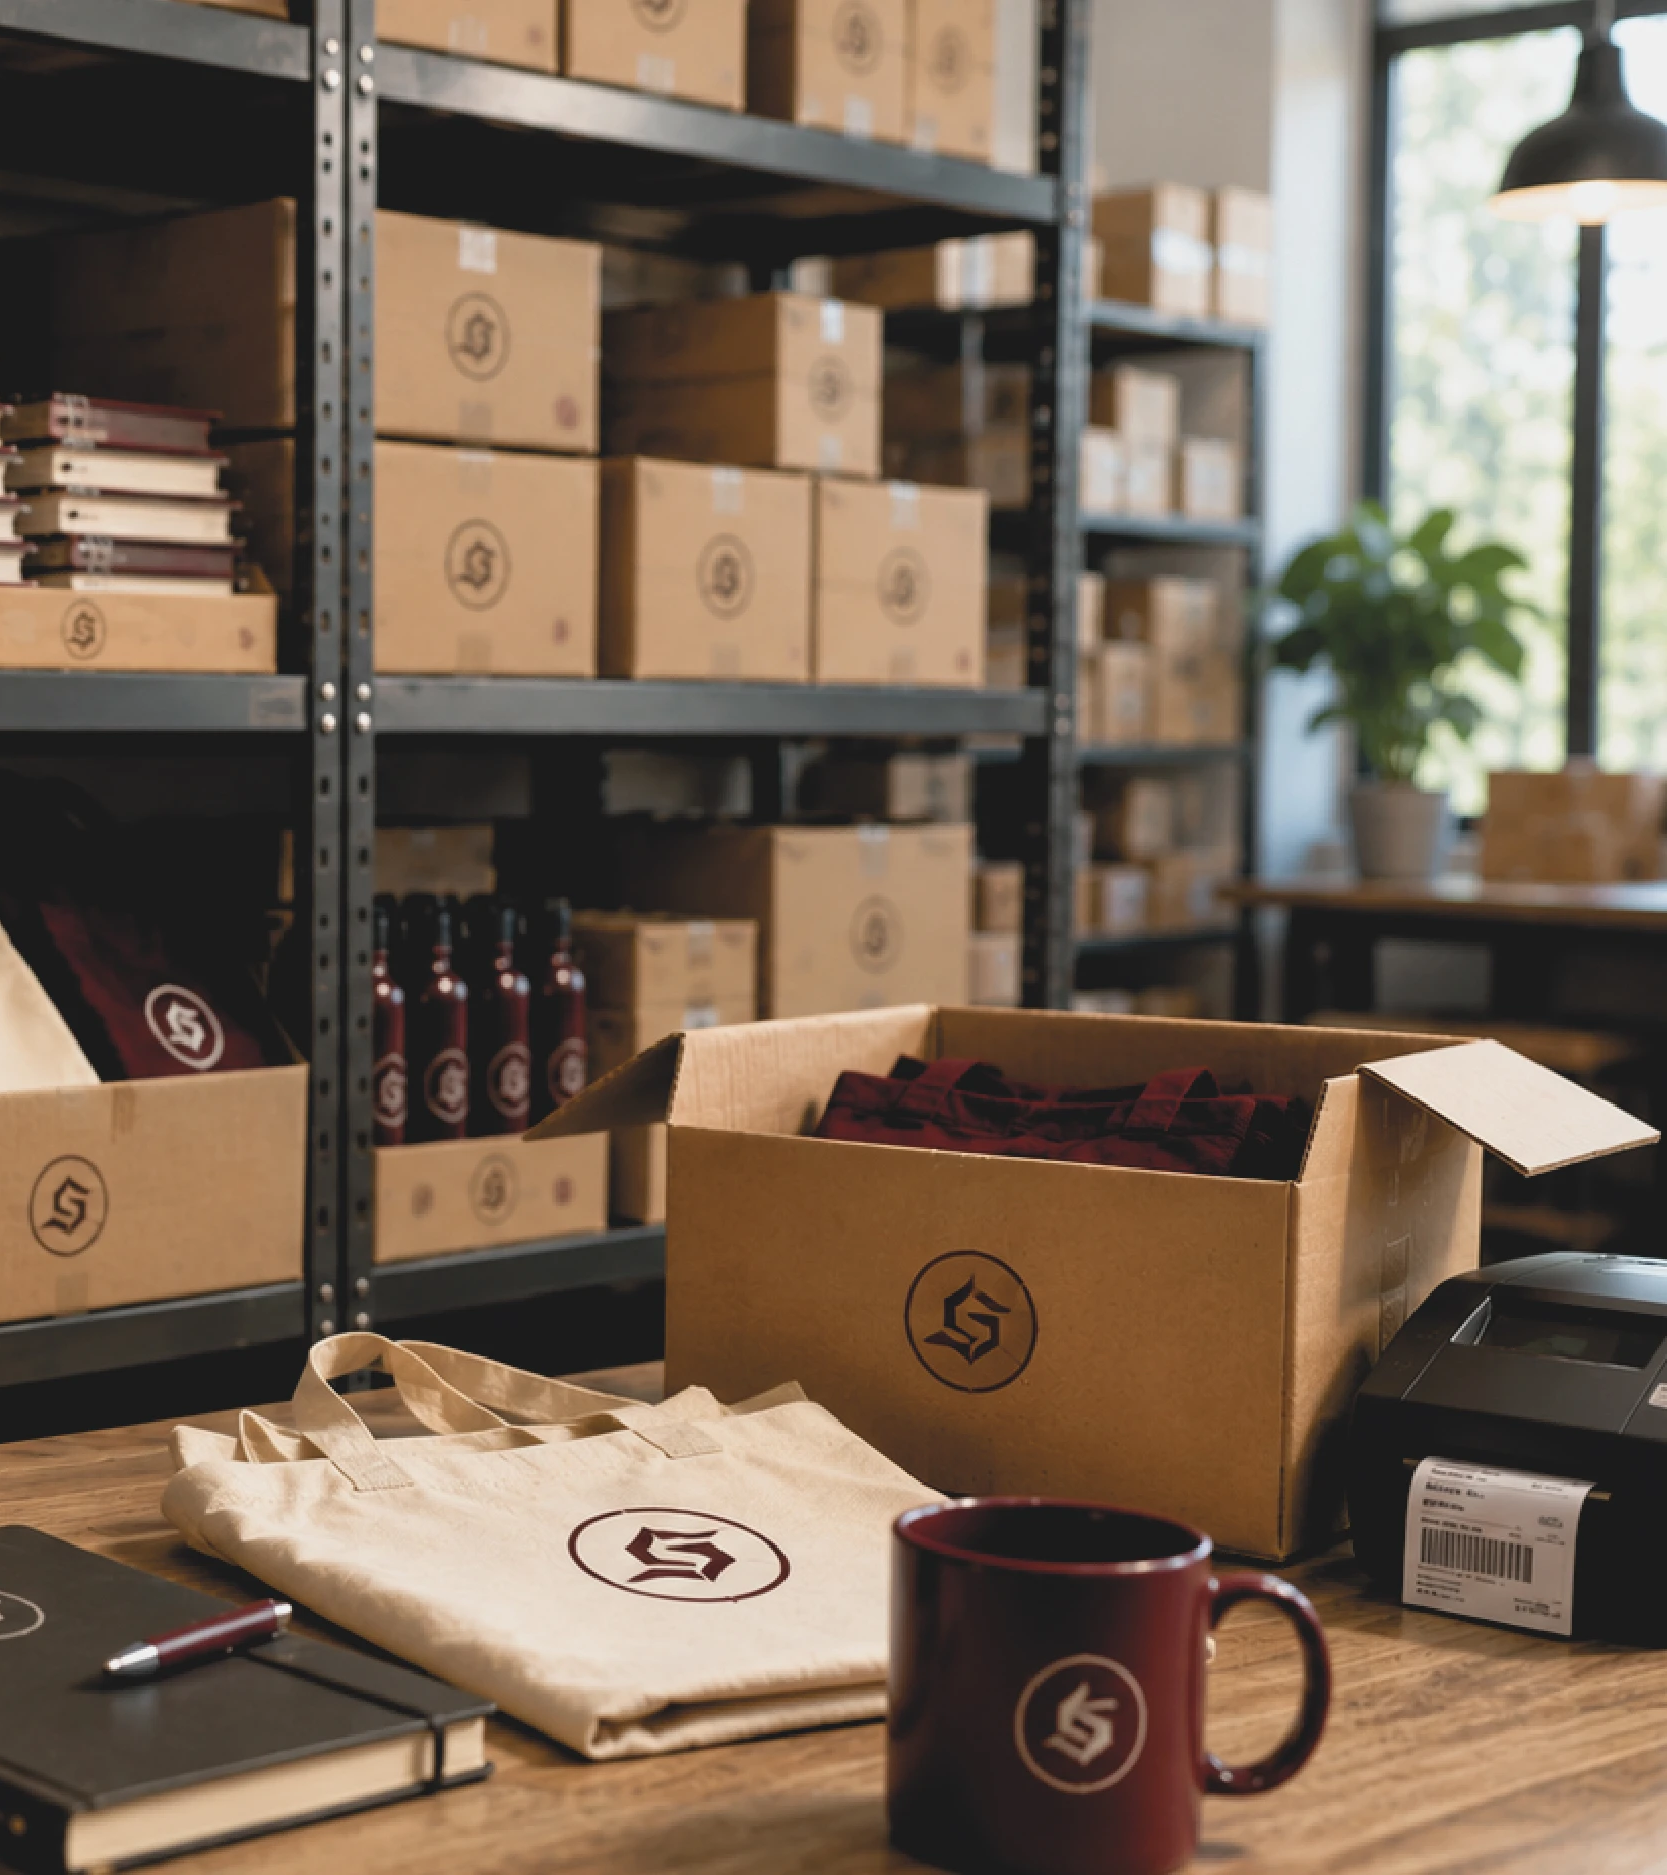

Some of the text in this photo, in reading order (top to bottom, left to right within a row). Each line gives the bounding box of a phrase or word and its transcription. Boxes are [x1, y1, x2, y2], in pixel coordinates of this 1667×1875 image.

[165, 1002, 205, 1050] S
[43, 1176, 90, 1235] S
[925, 1274, 1012, 1365] S
[626, 1526, 736, 1582] S
[1044, 1680, 1119, 1766] S
